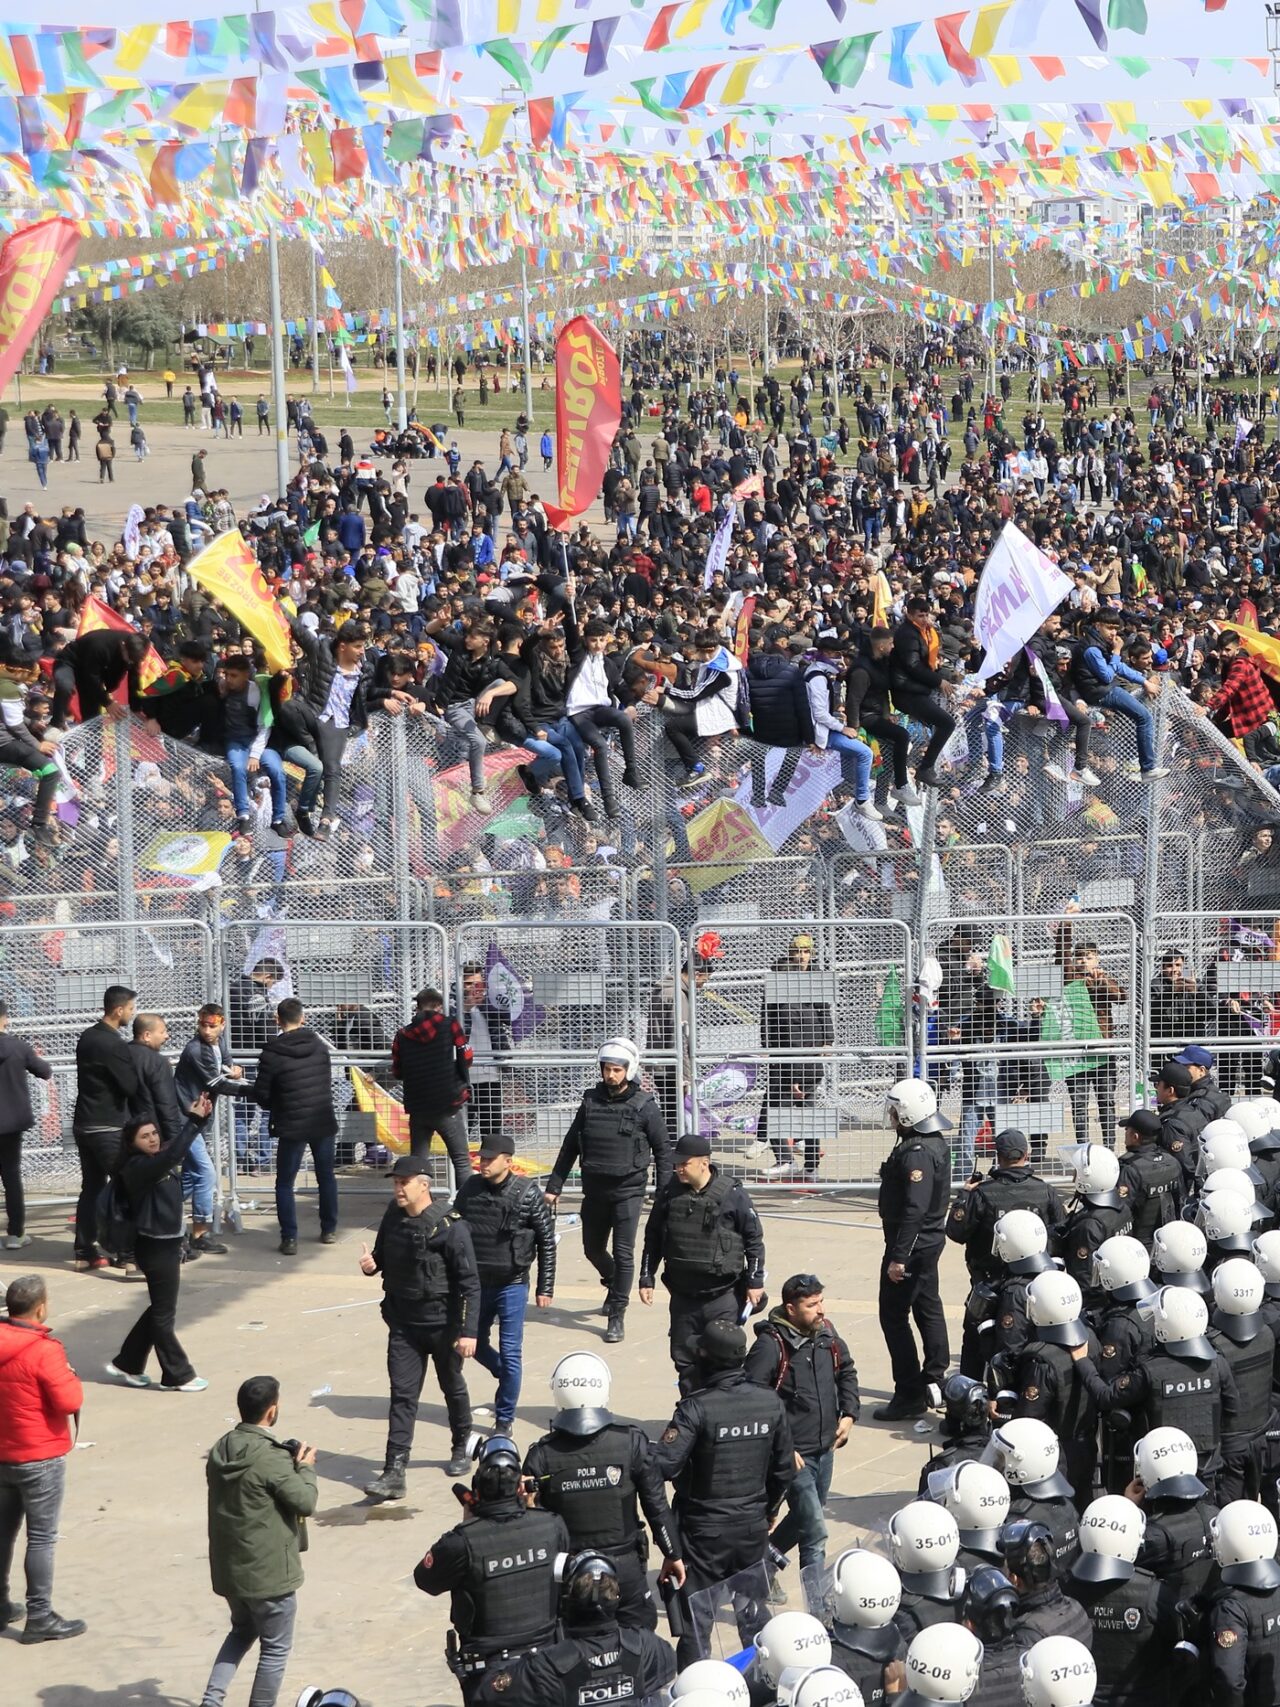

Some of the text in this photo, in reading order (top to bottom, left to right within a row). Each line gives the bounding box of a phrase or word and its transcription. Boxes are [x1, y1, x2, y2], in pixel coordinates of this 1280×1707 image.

[1233, 1288, 1254, 1298] 3317
[558, 1376, 603, 1389] 35-02-03
[1165, 1376, 1212, 1394] POLİS
[719, 1422, 771, 1438] POLİS
[1007, 1471, 1018, 1480] 21
[582, 1478, 607, 1489] KUVVET
[1248, 1524, 1273, 1537] 3202
[915, 1529, 959, 1550] 35-01-
[488, 1548, 548, 1573] POLİS
[1098, 1619, 1125, 1631] KUVVET
[580, 1680, 634, 1704] POLİS
